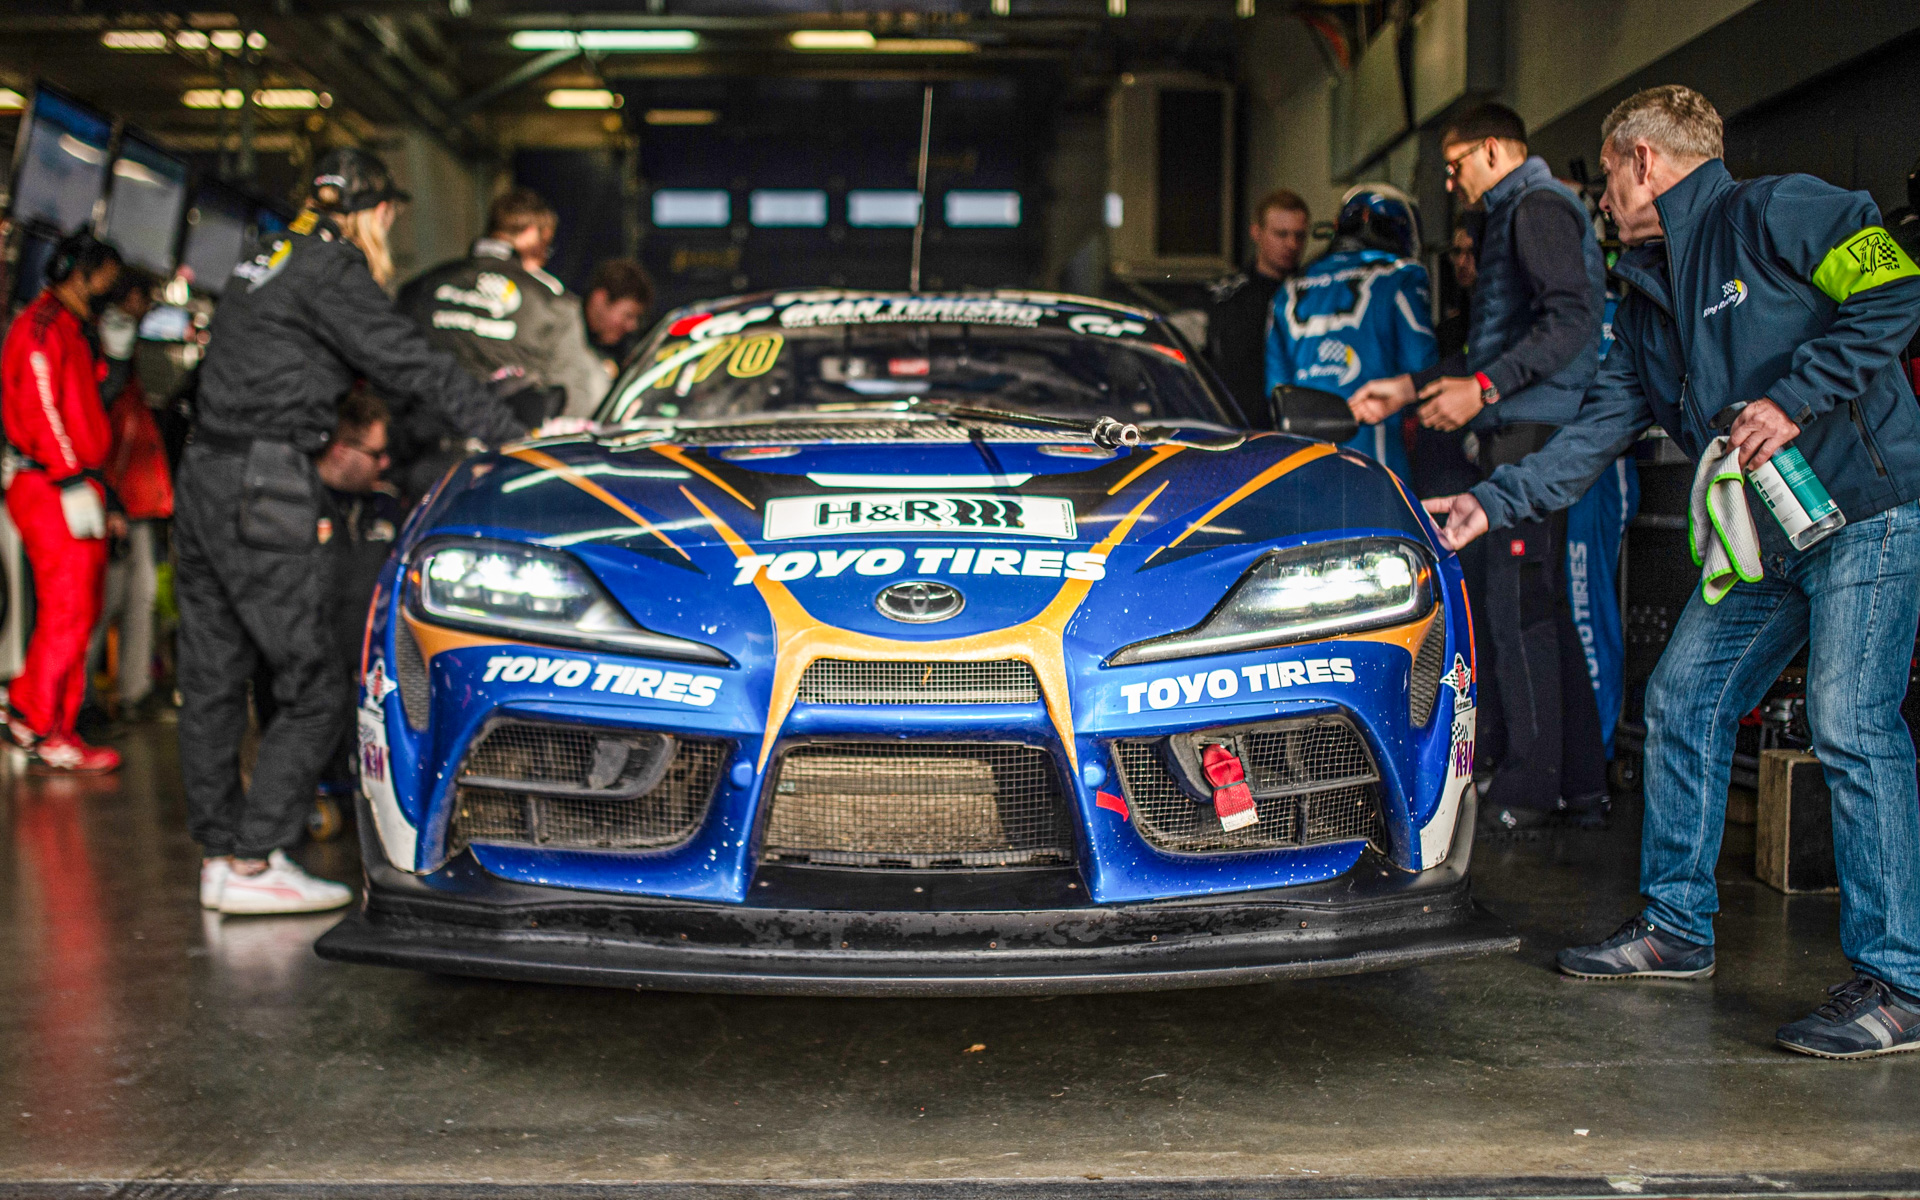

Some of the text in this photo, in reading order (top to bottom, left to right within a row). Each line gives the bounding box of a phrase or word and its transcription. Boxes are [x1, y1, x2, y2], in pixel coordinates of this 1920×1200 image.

[1885, 263, 1900, 271] VLN
[779, 300, 1043, 323] GRAN TURISMO
[816, 500, 944, 526] H&R
[733, 548, 1107, 586] TOYO TIRES
[1569, 540, 1591, 622] TIRES
[482, 656, 723, 707] TOYO TIRES
[1120, 657, 1356, 714] TOYO TIRES
